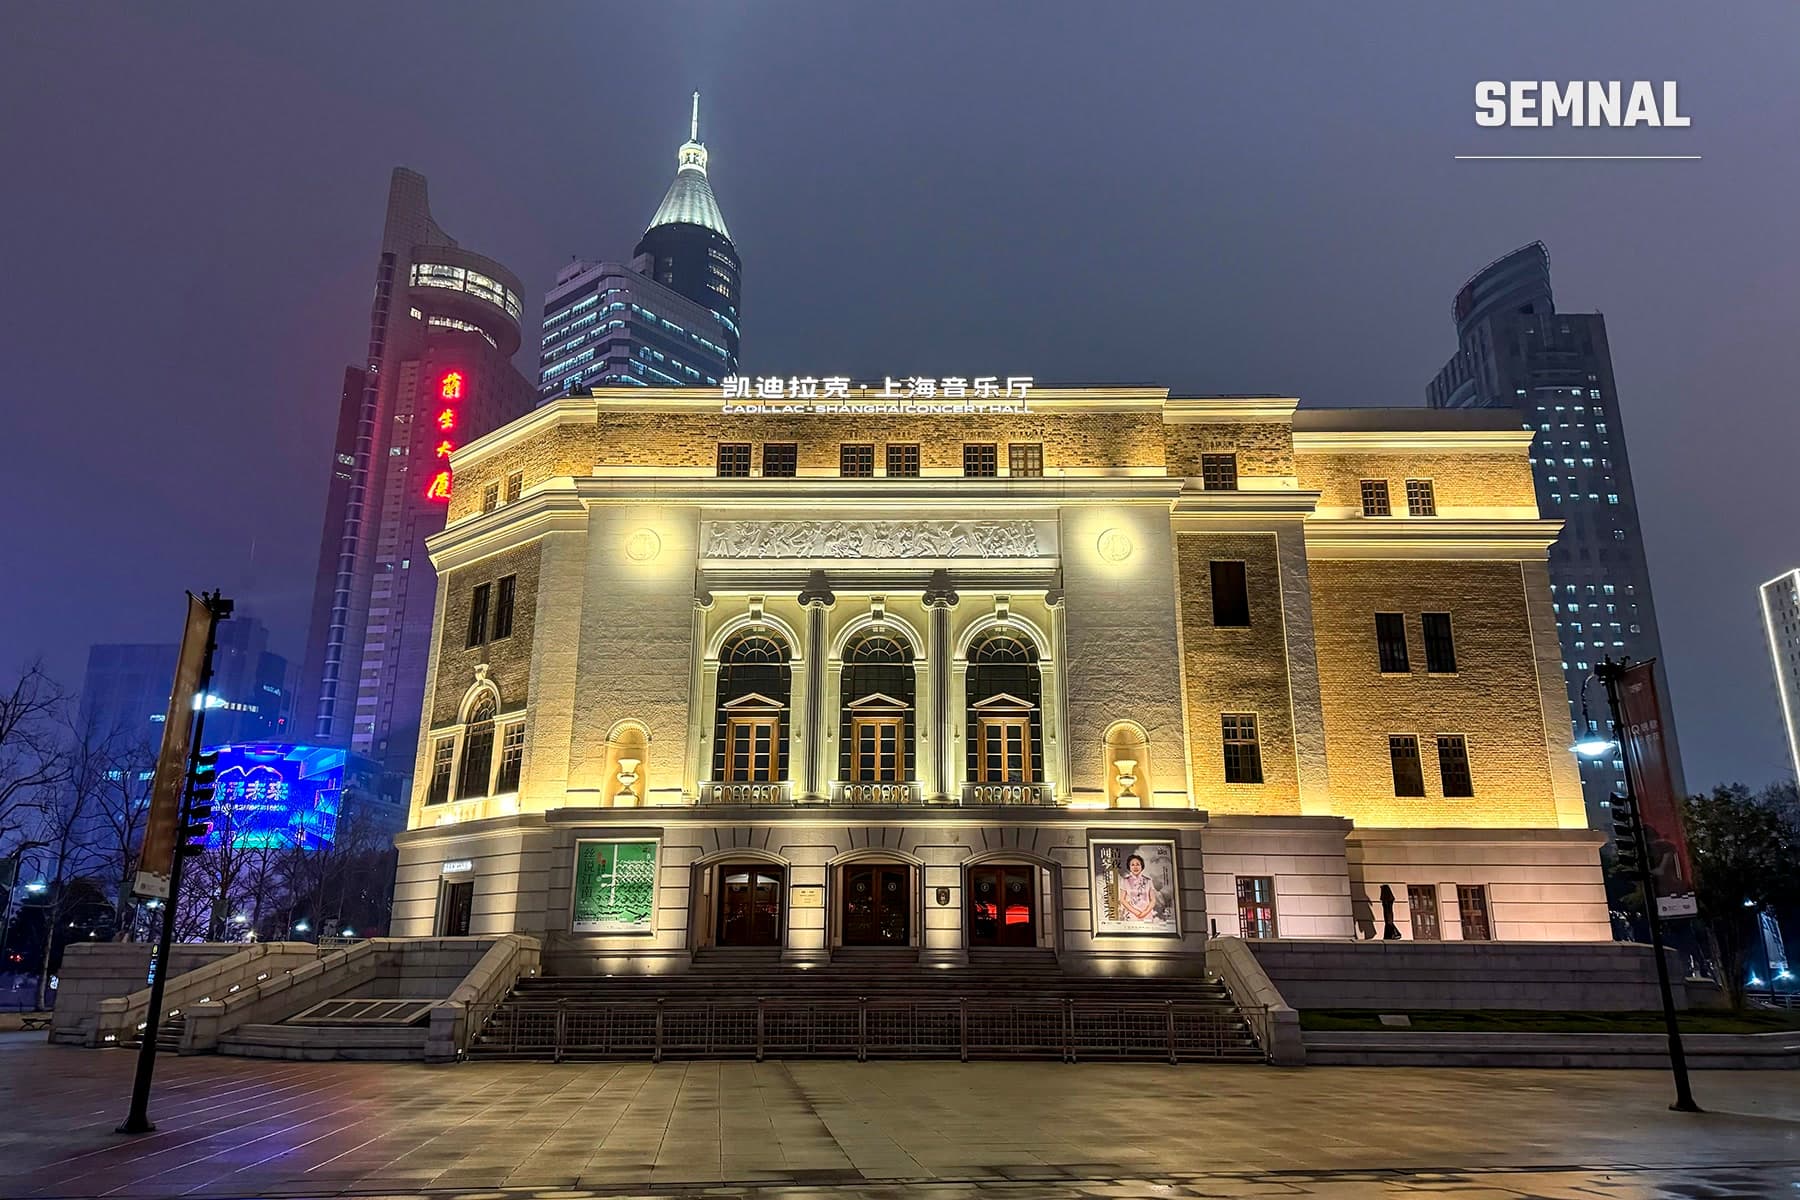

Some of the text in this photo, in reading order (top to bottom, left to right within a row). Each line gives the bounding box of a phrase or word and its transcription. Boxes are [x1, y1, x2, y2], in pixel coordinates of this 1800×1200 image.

[723, 405, 805, 414] CADILLAC
[815, 405, 904, 414] SHANGHAI
[905, 405, 987, 414] CONCERT
[988, 405, 1034, 414] HALL
